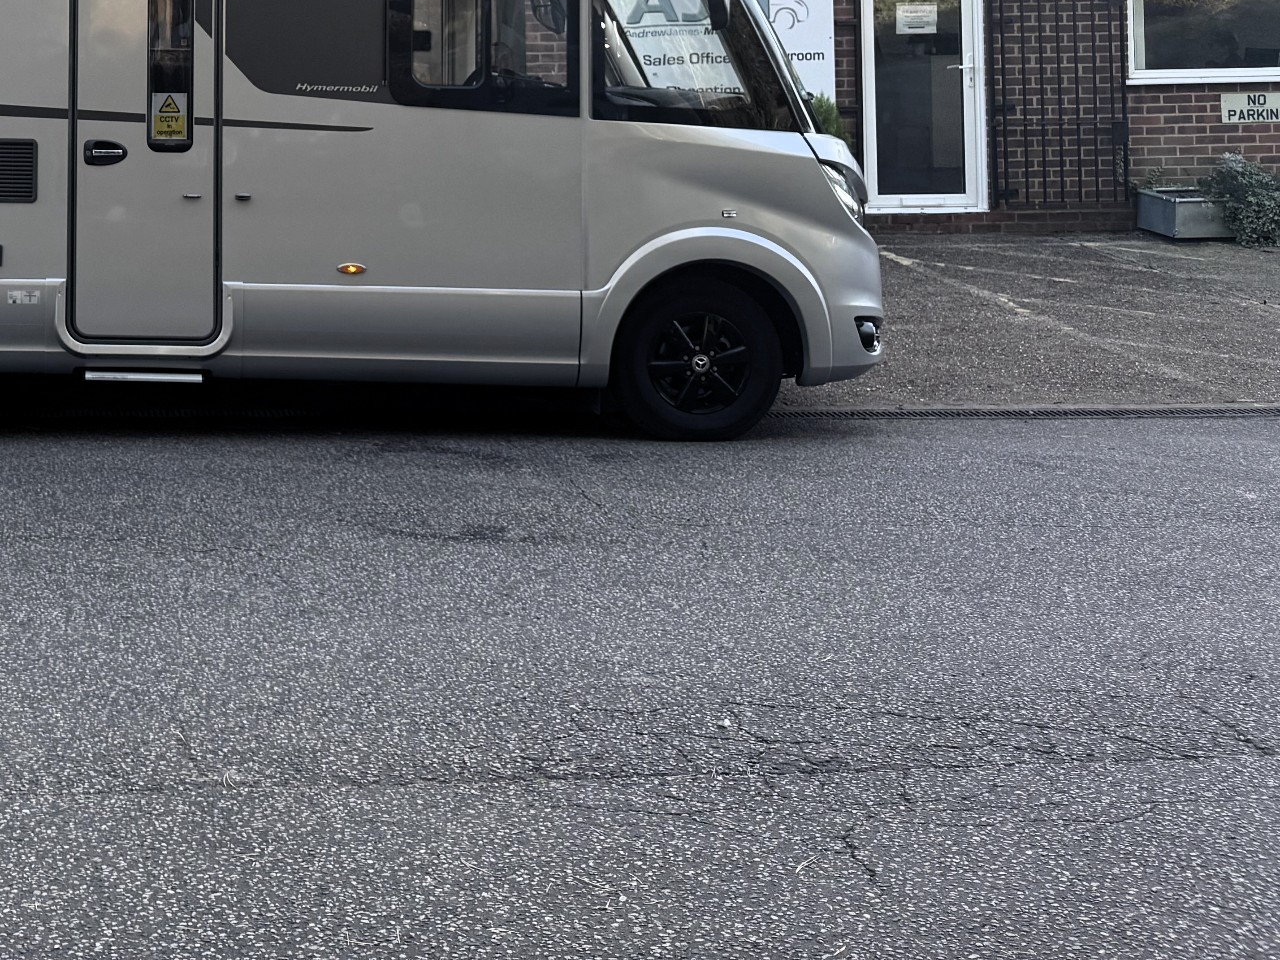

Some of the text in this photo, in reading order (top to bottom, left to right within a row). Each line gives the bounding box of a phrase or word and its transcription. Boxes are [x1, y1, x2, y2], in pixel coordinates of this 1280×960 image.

[642, 51, 825, 67] Sales Office room
[295, 83, 379, 93] Hymermobil
[1247, 94, 1266, 106] NO
[1228, 108, 1280, 121] PARKIN
